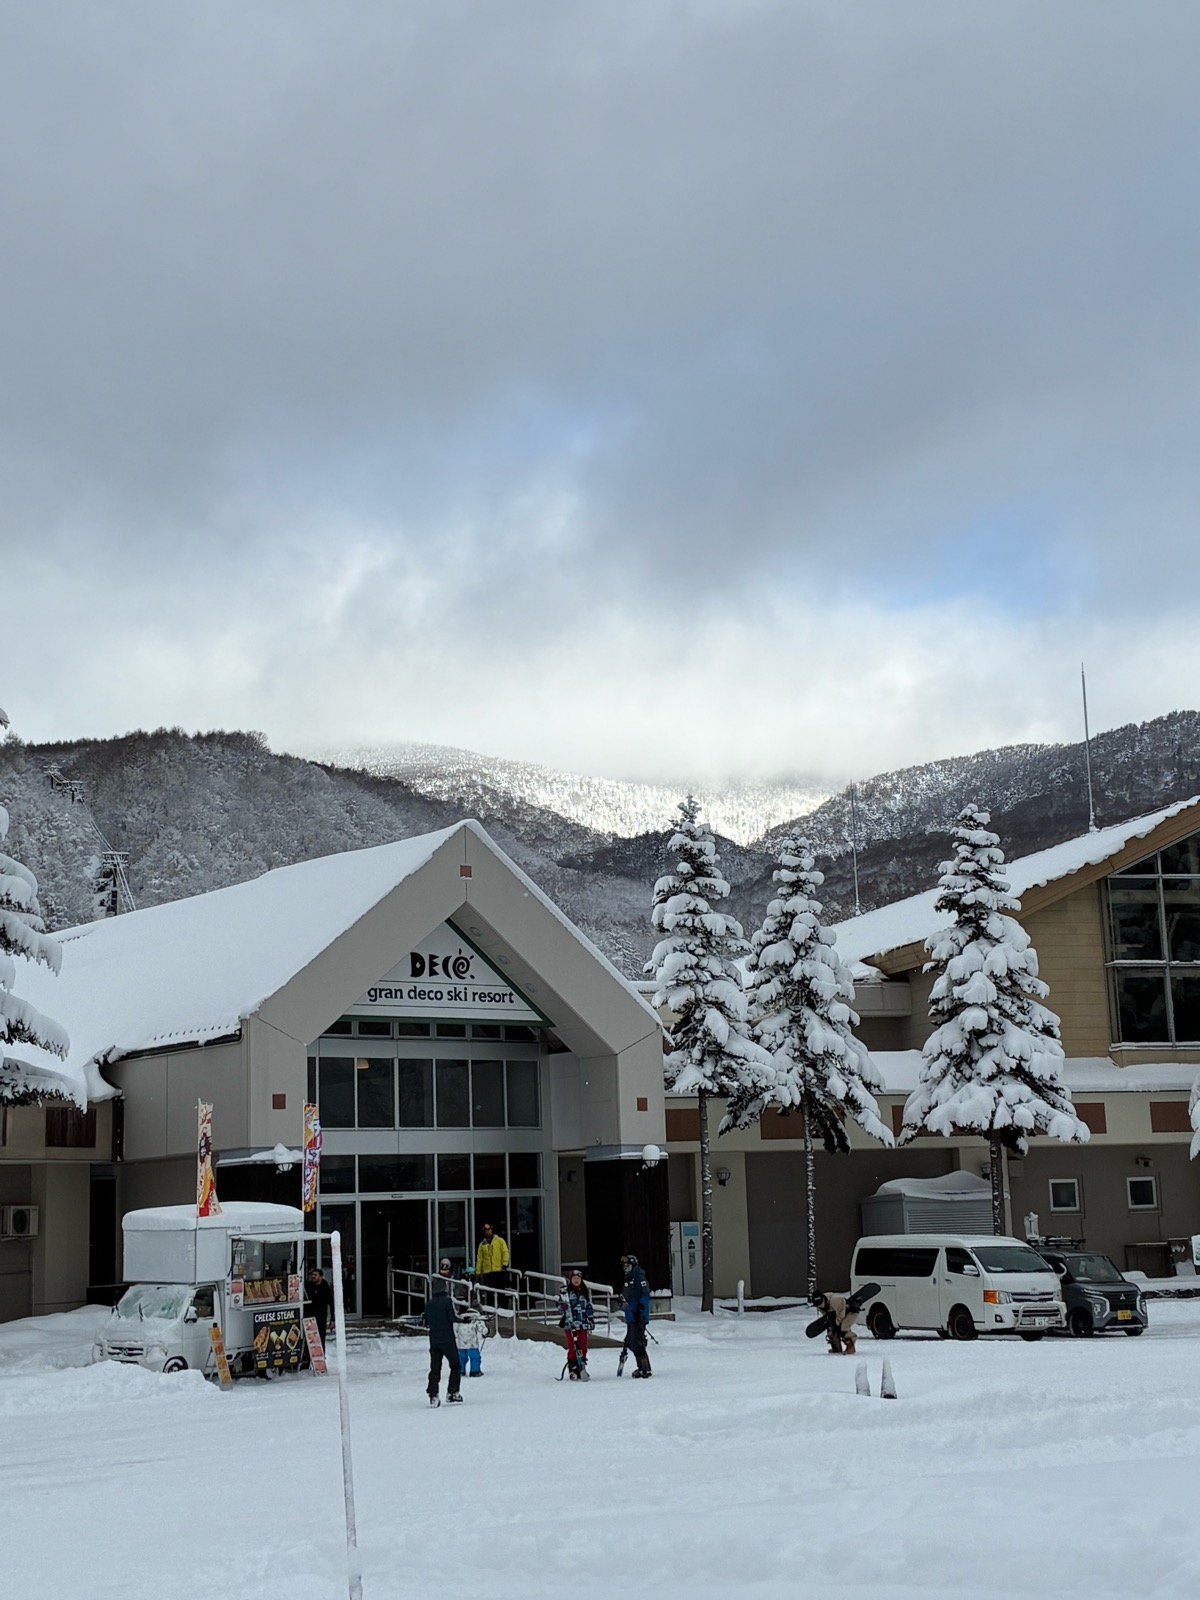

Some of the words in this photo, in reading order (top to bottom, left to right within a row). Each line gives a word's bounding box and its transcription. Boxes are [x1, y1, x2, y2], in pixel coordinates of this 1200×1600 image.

[367, 987, 403, 1002] gran
[407, 985, 444, 1001] deco
[447, 987, 468, 1002] ski
[472, 990, 515, 1003] resort
[254, 1312, 276, 1323] CHEESE
[276, 1310, 295, 1320] STEAK
